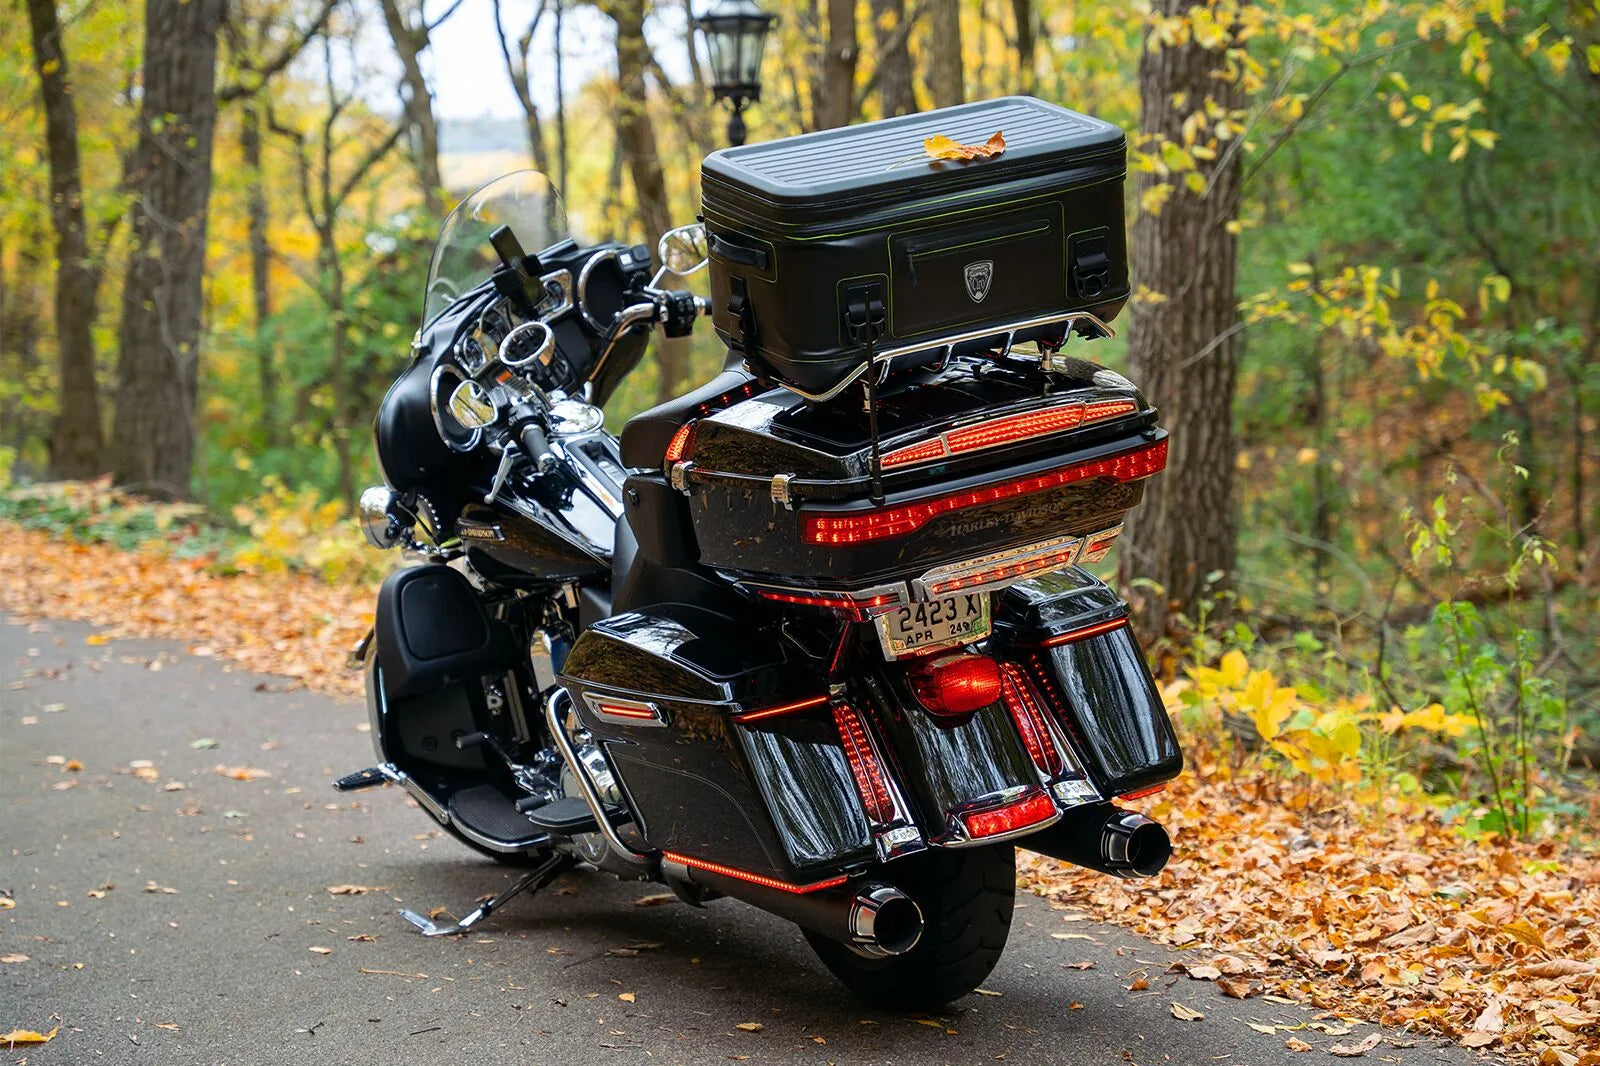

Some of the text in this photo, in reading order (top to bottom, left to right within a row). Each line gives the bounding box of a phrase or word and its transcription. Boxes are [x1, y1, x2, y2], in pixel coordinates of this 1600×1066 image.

[950, 501, 1065, 537] HARLEY-DAVIDSON
[899, 597, 958, 633] 2423
[906, 630, 934, 646] APR
